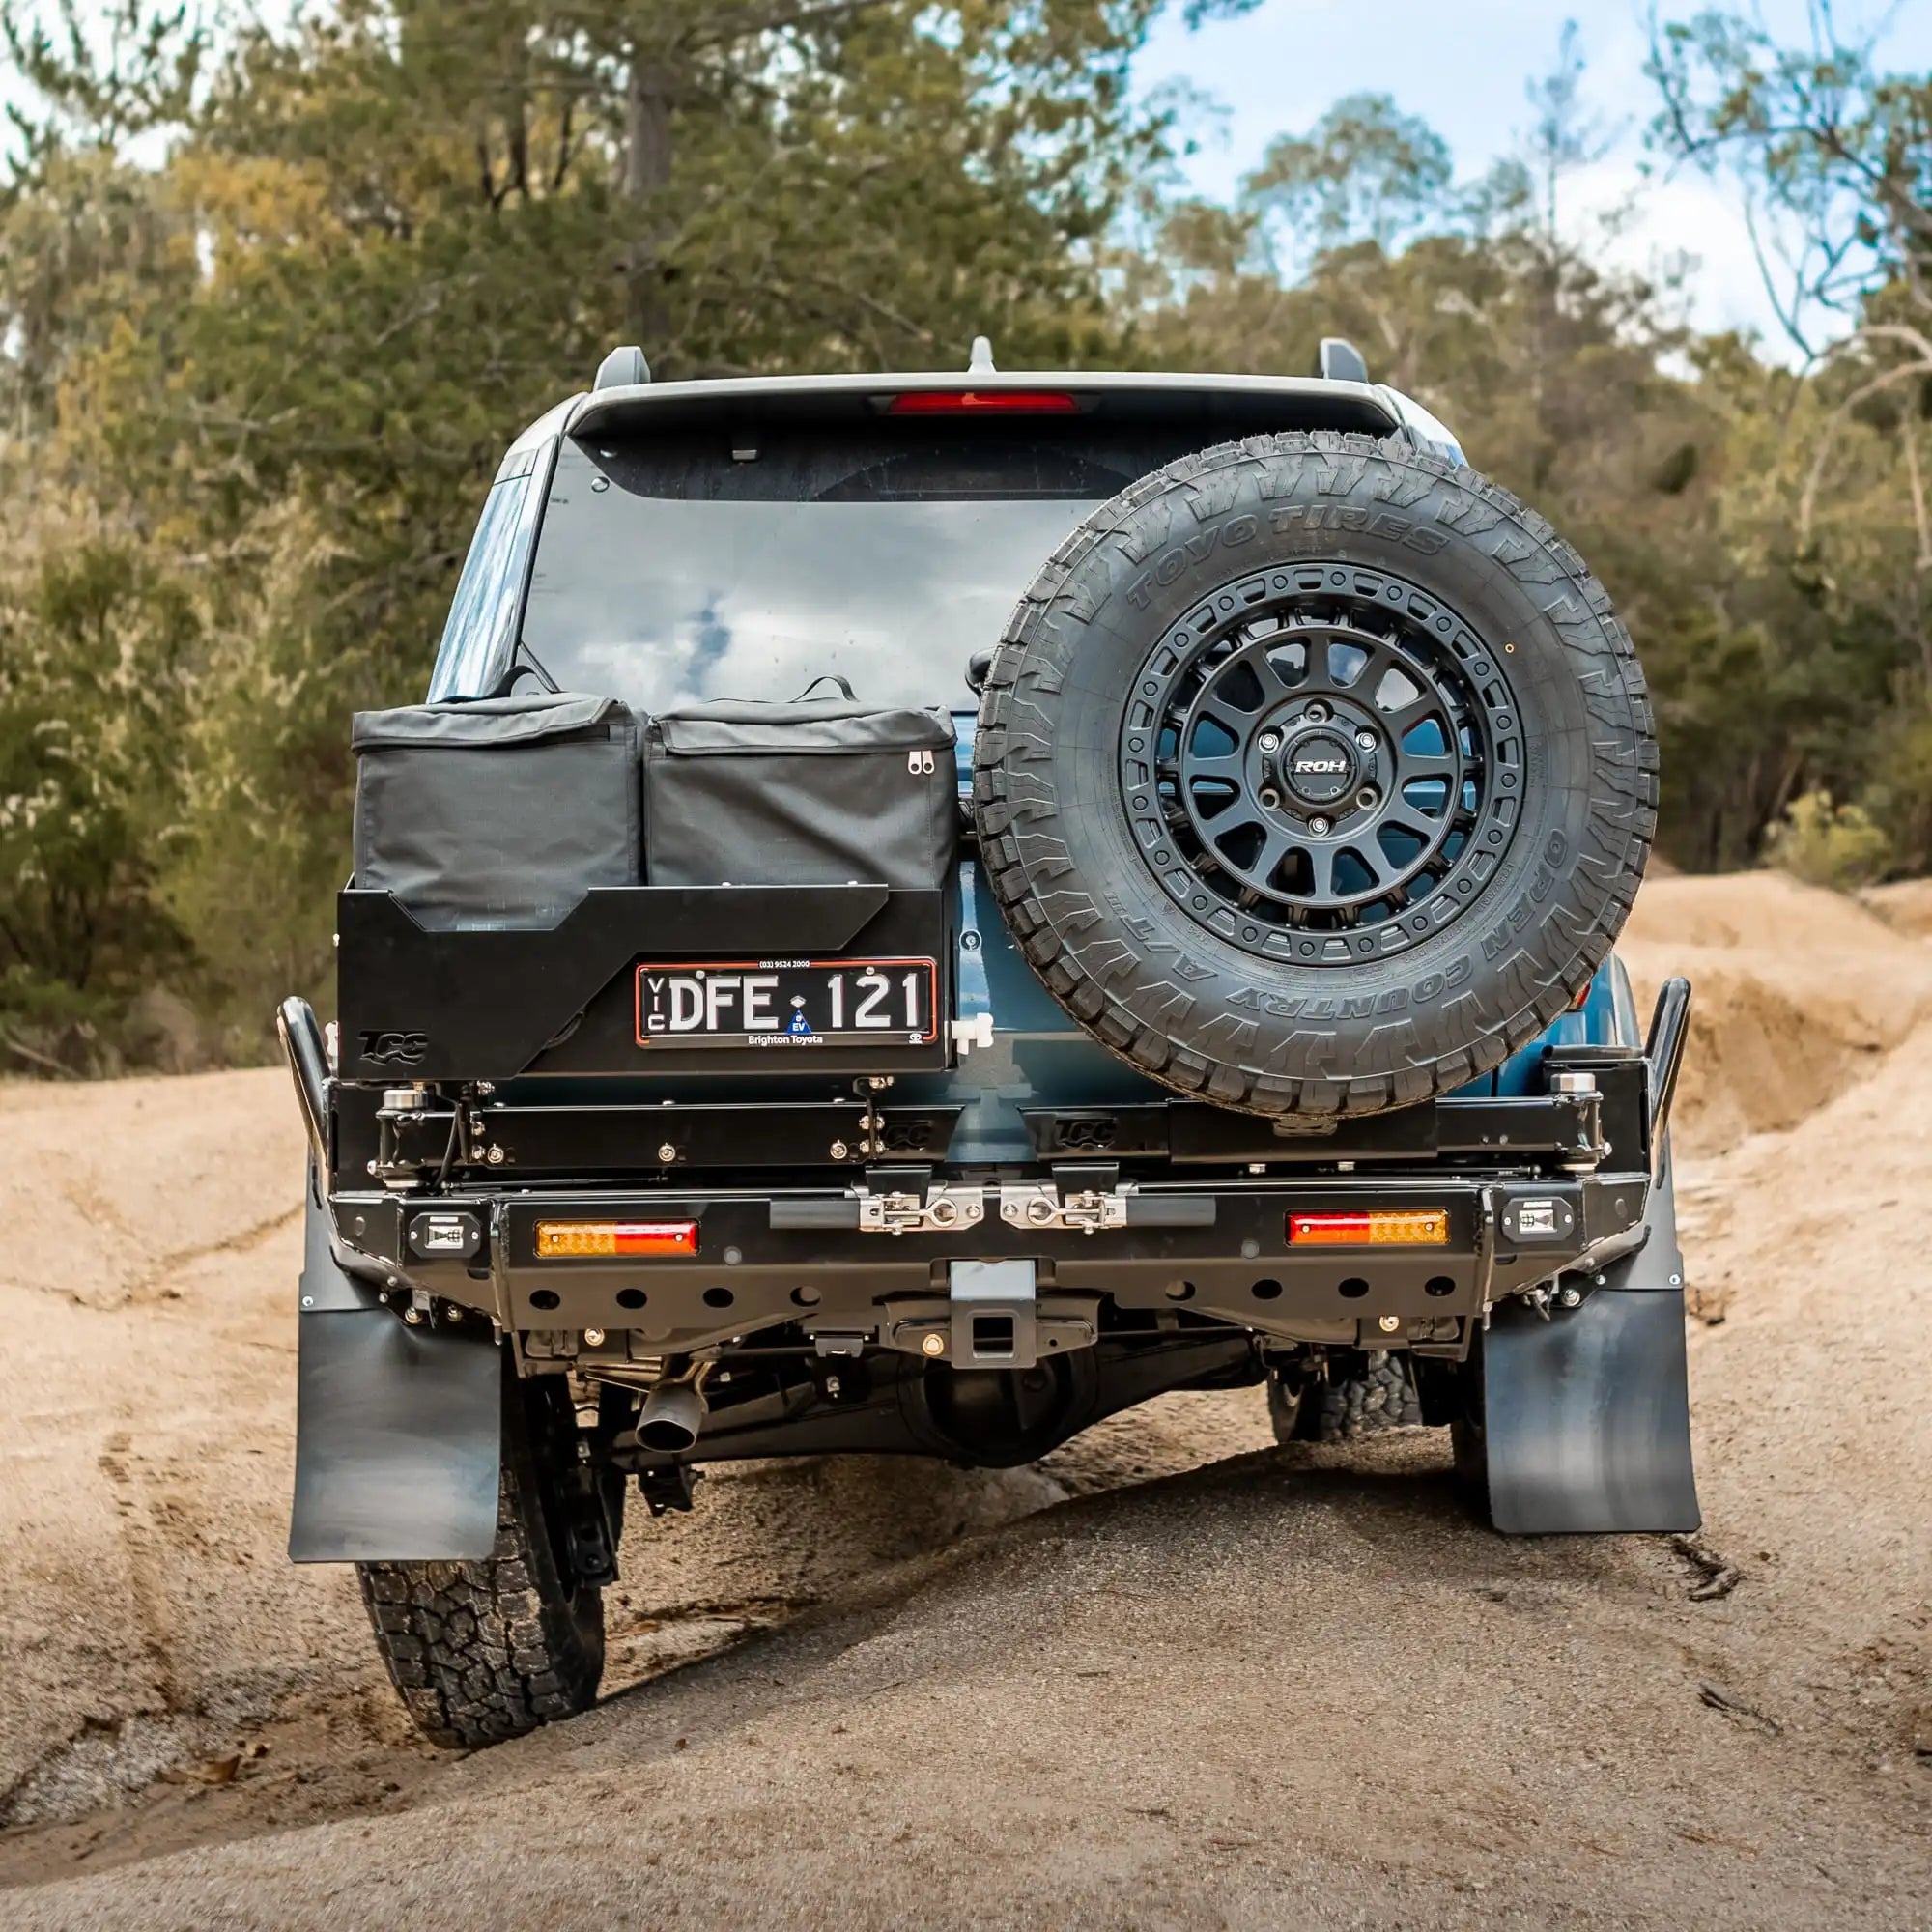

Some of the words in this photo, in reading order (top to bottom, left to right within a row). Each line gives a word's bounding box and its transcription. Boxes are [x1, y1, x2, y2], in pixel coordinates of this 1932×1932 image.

[1267, 503, 1451, 556] TIRES
[1294, 760, 1347, 773] ROH
[1480, 828, 1569, 961] OPEN
[758, 960, 774, 969] (03)
[1225, 954, 1473, 1020] COUNTRY
[647, 977, 666, 1030] VIC
[668, 974, 779, 1031] DFE
[827, 972, 918, 1029] 121
[792, 1022, 806, 1032] EV
[748, 1035, 790, 1047] Brighton
[790, 1035, 823, 1046] Toyota
